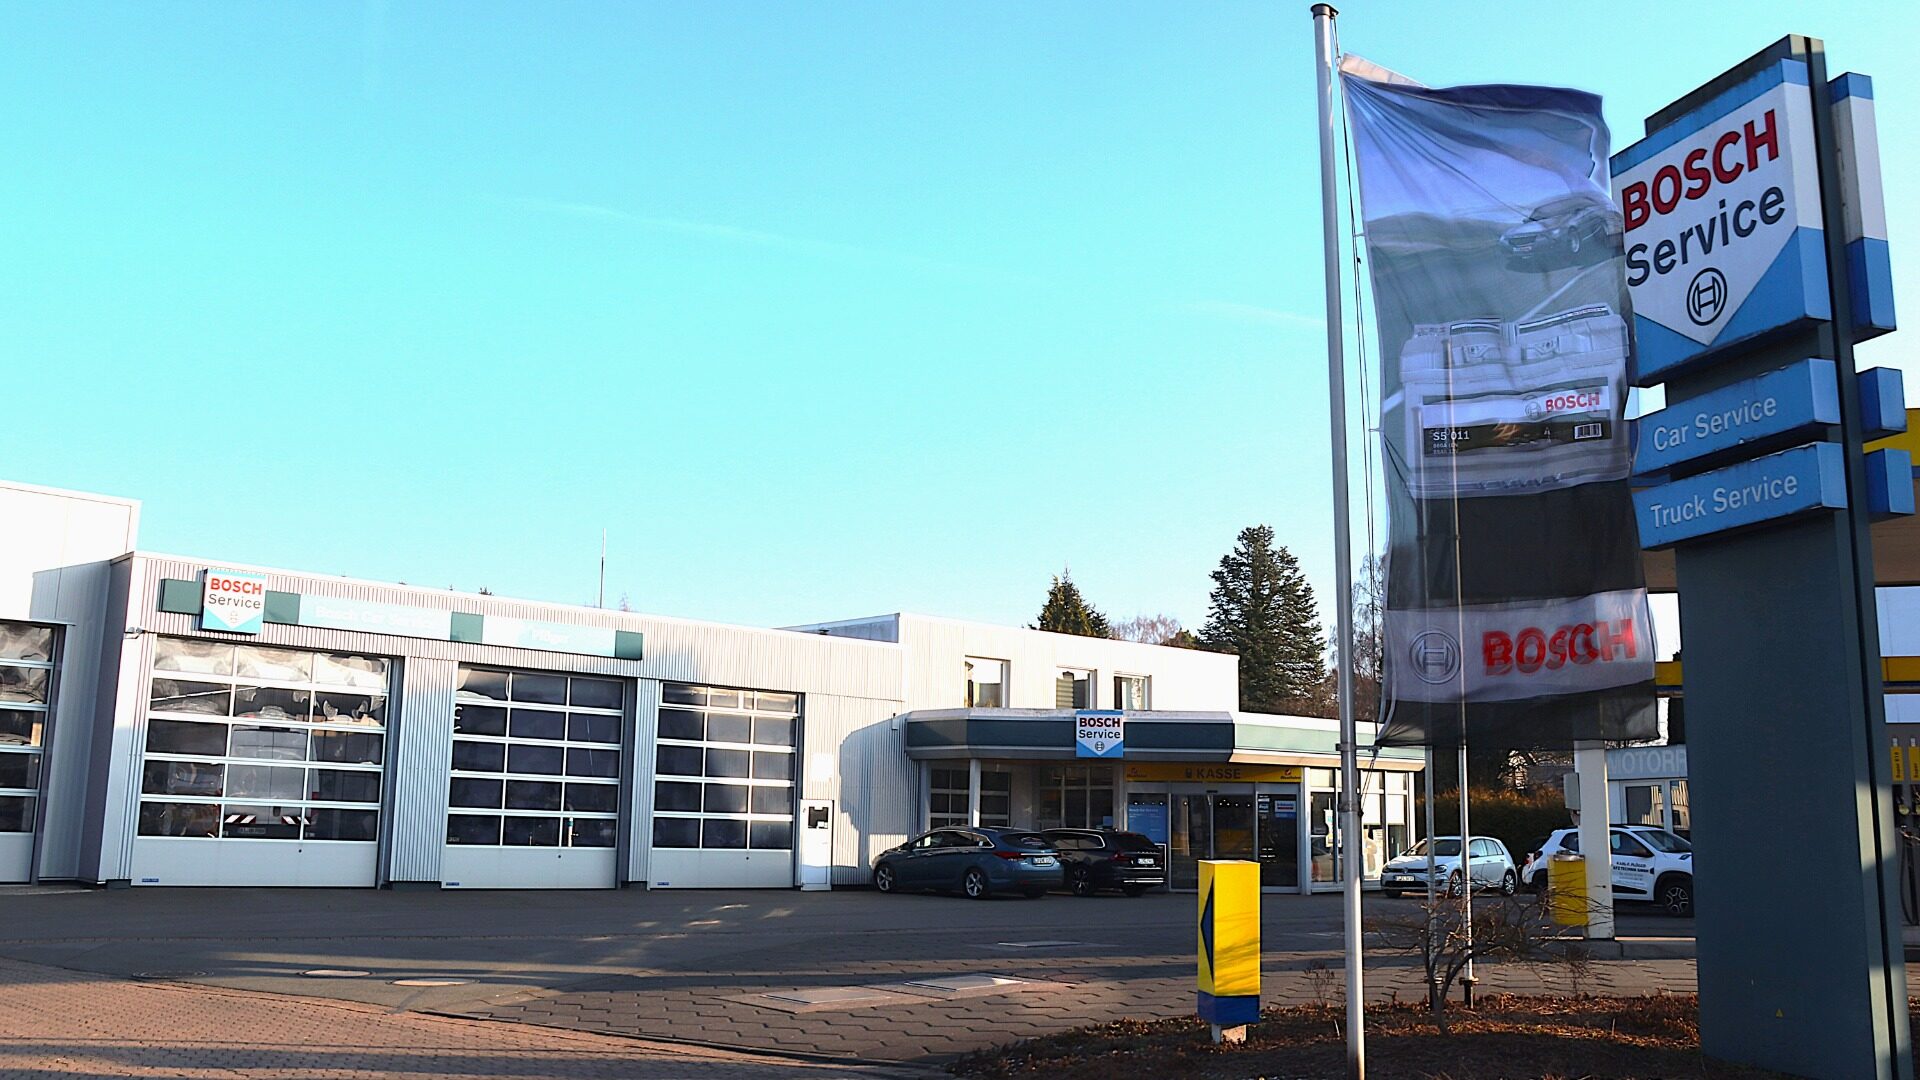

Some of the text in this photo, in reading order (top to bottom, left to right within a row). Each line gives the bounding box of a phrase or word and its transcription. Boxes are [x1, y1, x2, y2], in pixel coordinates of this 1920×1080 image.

[1621, 108, 1780, 234] BOSCH
[1625, 186, 1786, 287] Service
[1545, 391, 1601, 413] BOSCH
[1653, 397, 1777, 451] Car Service
[1432, 431, 1448, 441] S5
[1650, 474, 1798, 528] Truck Service
[210, 577, 263, 595] BOSCH
[208, 593, 261, 609] Service
[1482, 618, 1638, 677] BOSCH
[1079, 717, 1121, 728] BOSCH
[1078, 728, 1121, 739] Service
[1196, 767, 1241, 780] KASSE
